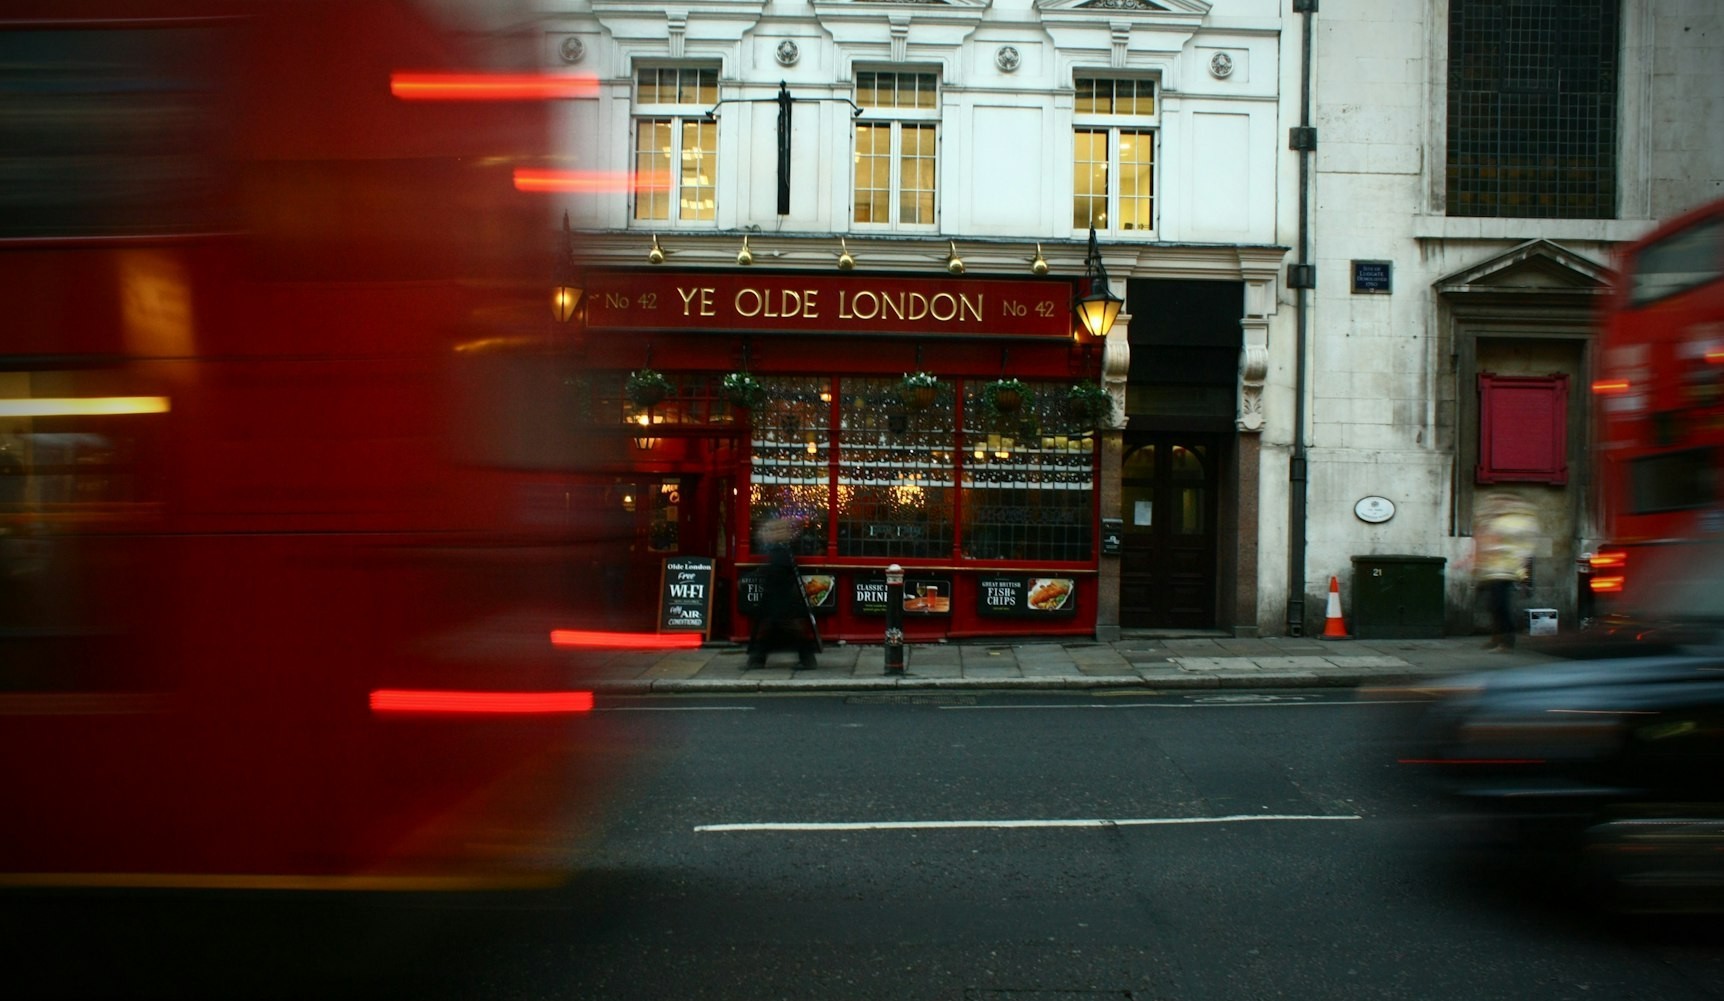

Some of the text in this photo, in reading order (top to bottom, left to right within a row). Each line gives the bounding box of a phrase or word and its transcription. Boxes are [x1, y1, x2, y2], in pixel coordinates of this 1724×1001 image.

[605, 287, 1056, 323] No 42 YE OLDE LONDON No 42
[684, 563, 712, 571] London
[677, 572, 697, 581] Free
[1372, 568, 1382, 577] 21
[669, 584, 705, 599] WI-FI
[856, 583, 884, 591] CLASSIC
[987, 587, 1010, 597] FISH
[986, 596, 1016, 606] CHIPS
